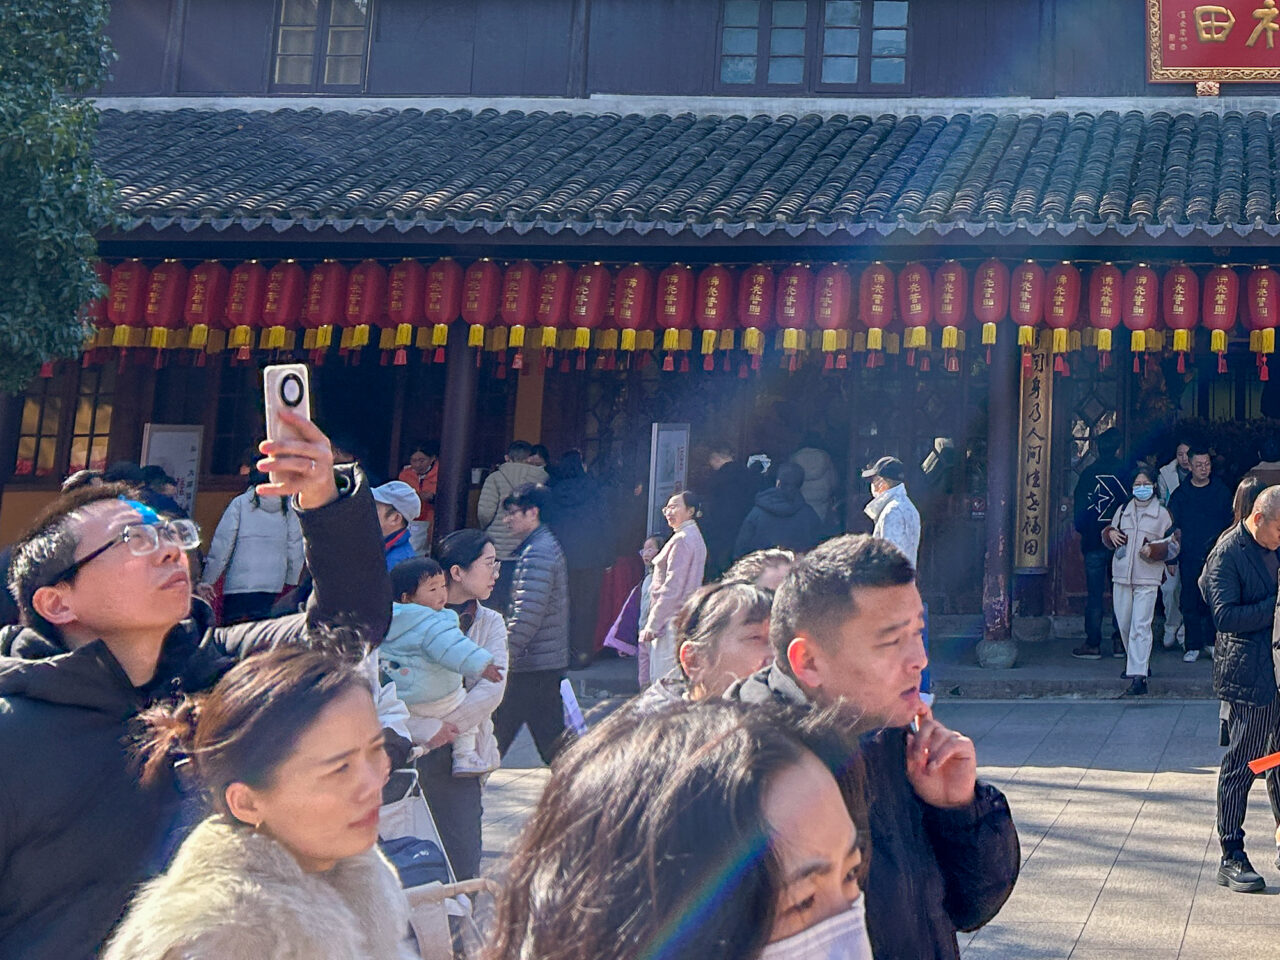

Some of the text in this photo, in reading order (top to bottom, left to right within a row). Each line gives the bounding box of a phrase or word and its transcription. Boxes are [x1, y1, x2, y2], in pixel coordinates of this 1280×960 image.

[575, 275, 592, 317] 佛光普照
[620, 278, 638, 319] 佛光普照
[664, 274, 680, 316] 佛光普照
[703, 276, 720, 318] 佛光普照
[748, 275, 765, 316] 佛光普照
[783, 276, 799, 317] 佛光普照
[819, 277, 834, 318] 佛光普照
[871, 274, 887, 315] 佛光普照
[908, 273, 923, 315] 佛光普照
[941, 273, 957, 315] 佛光普照
[982, 268, 997, 309] 佛光普照
[1019, 272, 1035, 313] 佛光普照
[1053, 275, 1068, 317] 佛光普照
[1100, 276, 1116, 317] 佛光普照
[1132, 276, 1148, 317] 佛光普照
[1172, 275, 1188, 316] 佛光普照
[1213, 276, 1230, 317] 佛光普照
[1255, 278, 1270, 318] 佛光普照
